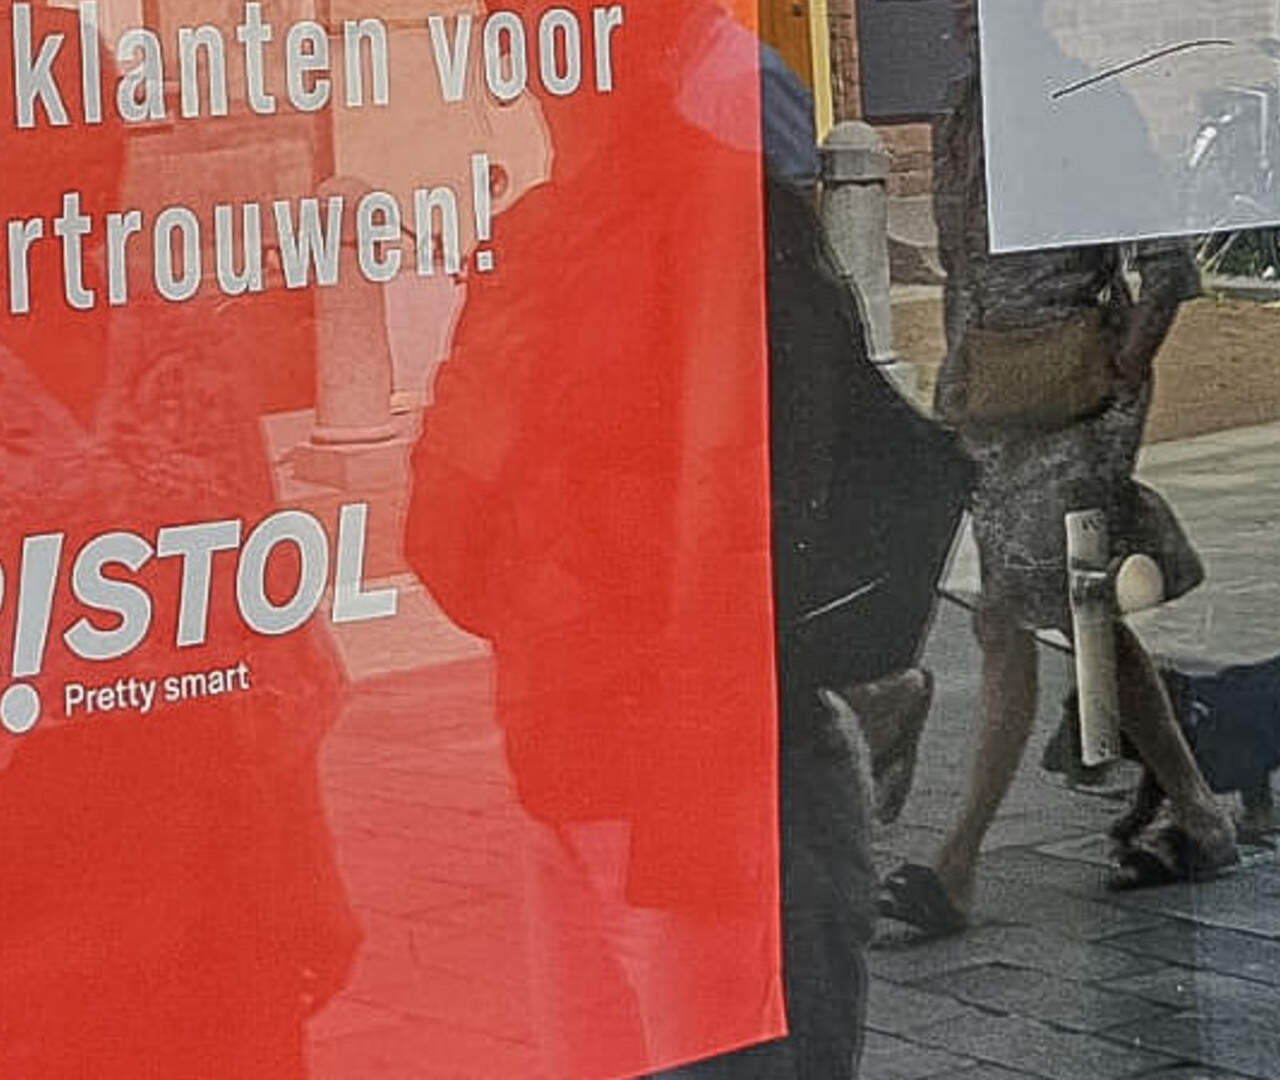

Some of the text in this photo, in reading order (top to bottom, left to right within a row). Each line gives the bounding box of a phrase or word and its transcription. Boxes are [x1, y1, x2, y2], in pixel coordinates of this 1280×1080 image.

[11, 0, 391, 130] klanten
[428, 0, 625, 102] voor
[64, 661, 251, 718] Pretty smart
